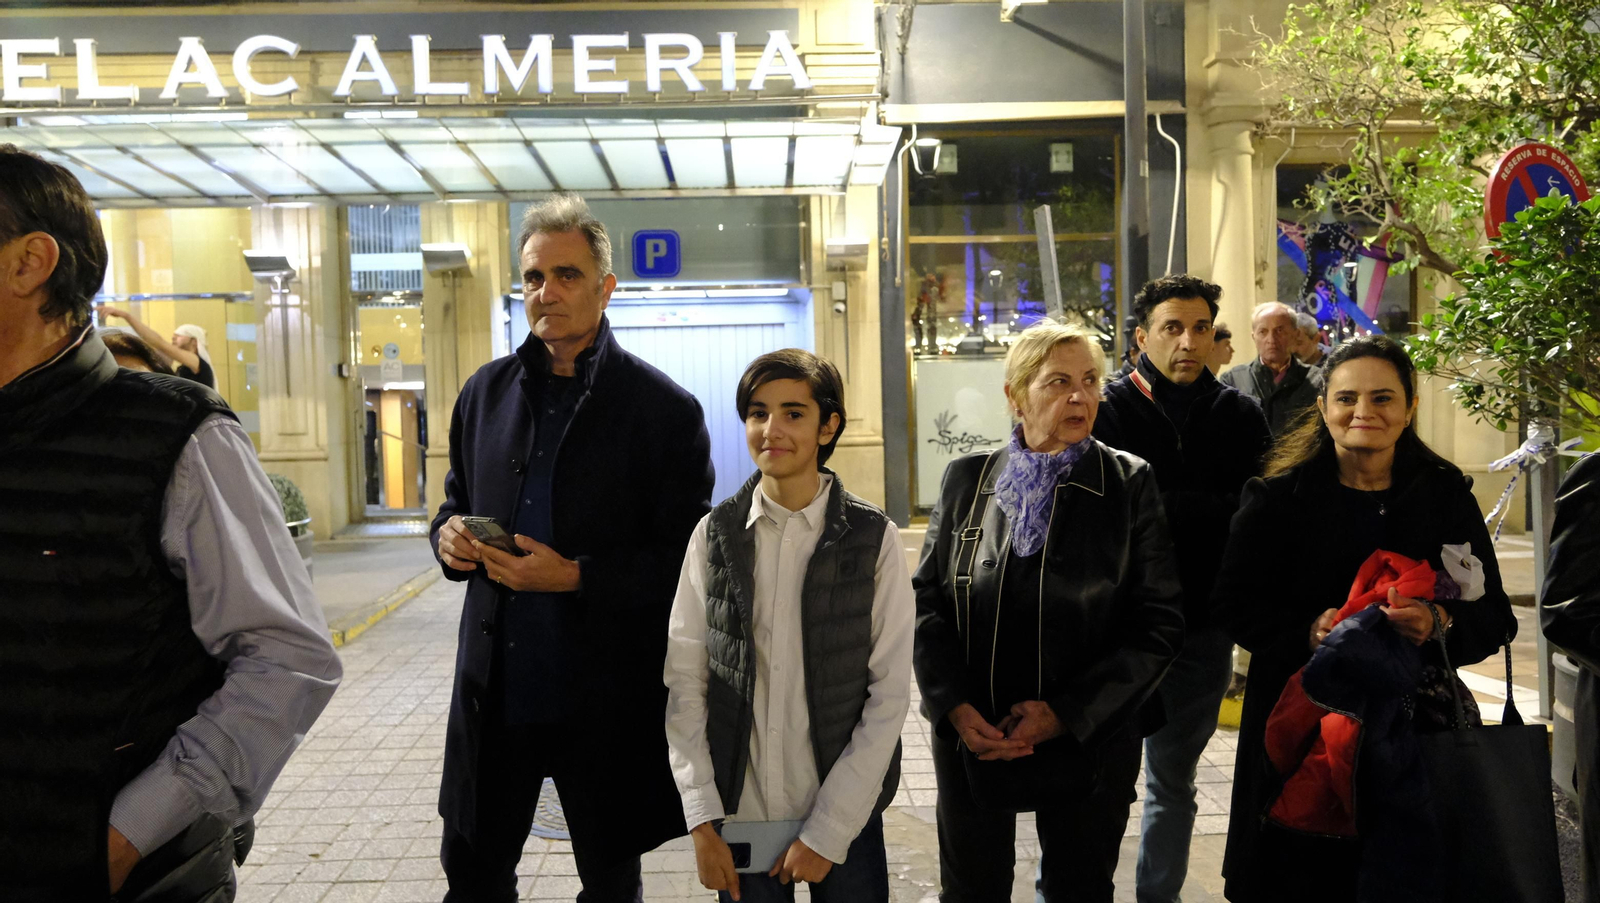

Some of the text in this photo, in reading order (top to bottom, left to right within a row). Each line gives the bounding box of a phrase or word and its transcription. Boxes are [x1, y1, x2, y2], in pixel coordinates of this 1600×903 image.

[0, 30, 814, 101] EL AC ALMERIA
[1501, 148, 1580, 187] RESERVA DE ESPACIO
[645, 238, 667, 269] P
[383, 361, 400, 371] AC
